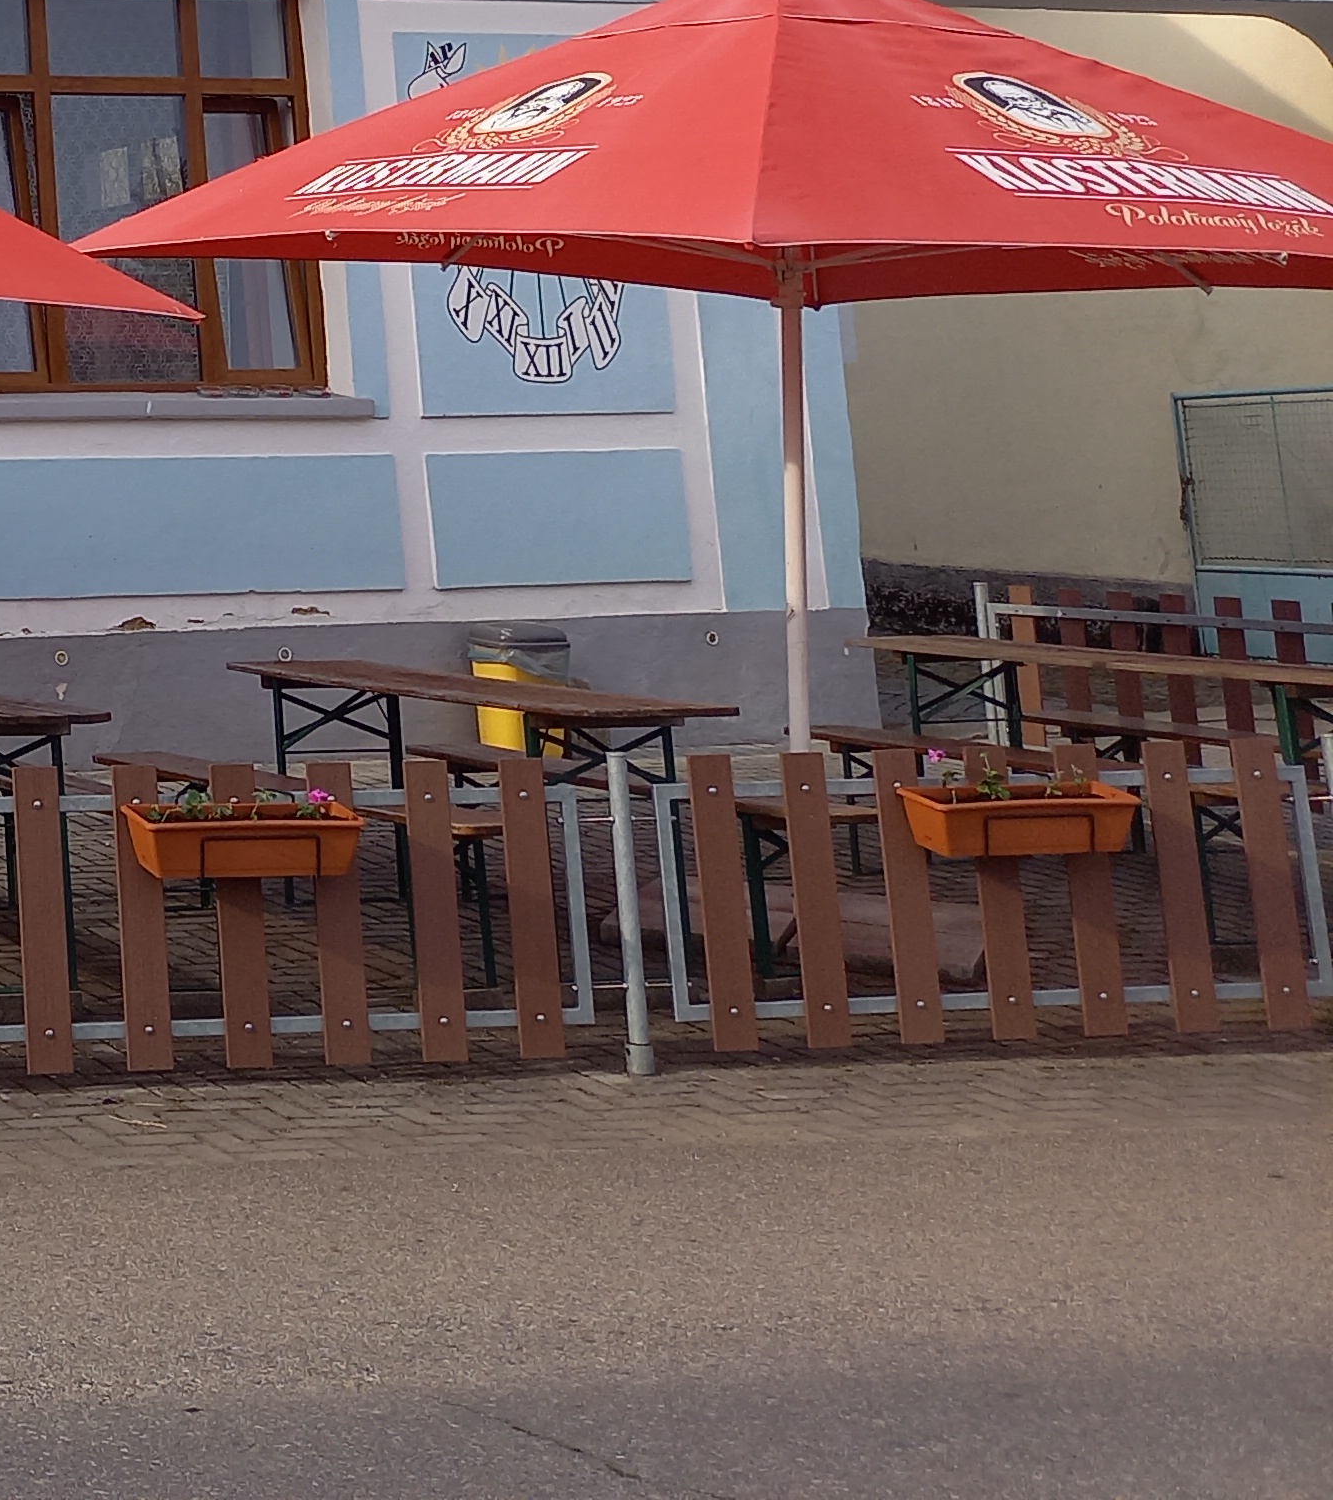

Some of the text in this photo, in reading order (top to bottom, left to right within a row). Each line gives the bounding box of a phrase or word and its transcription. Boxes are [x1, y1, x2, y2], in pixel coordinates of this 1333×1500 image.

[954, 153, 1333, 214] KLOSTERMANN
[521, 341, 568, 378] XII
[589, 301, 617, 361] II
